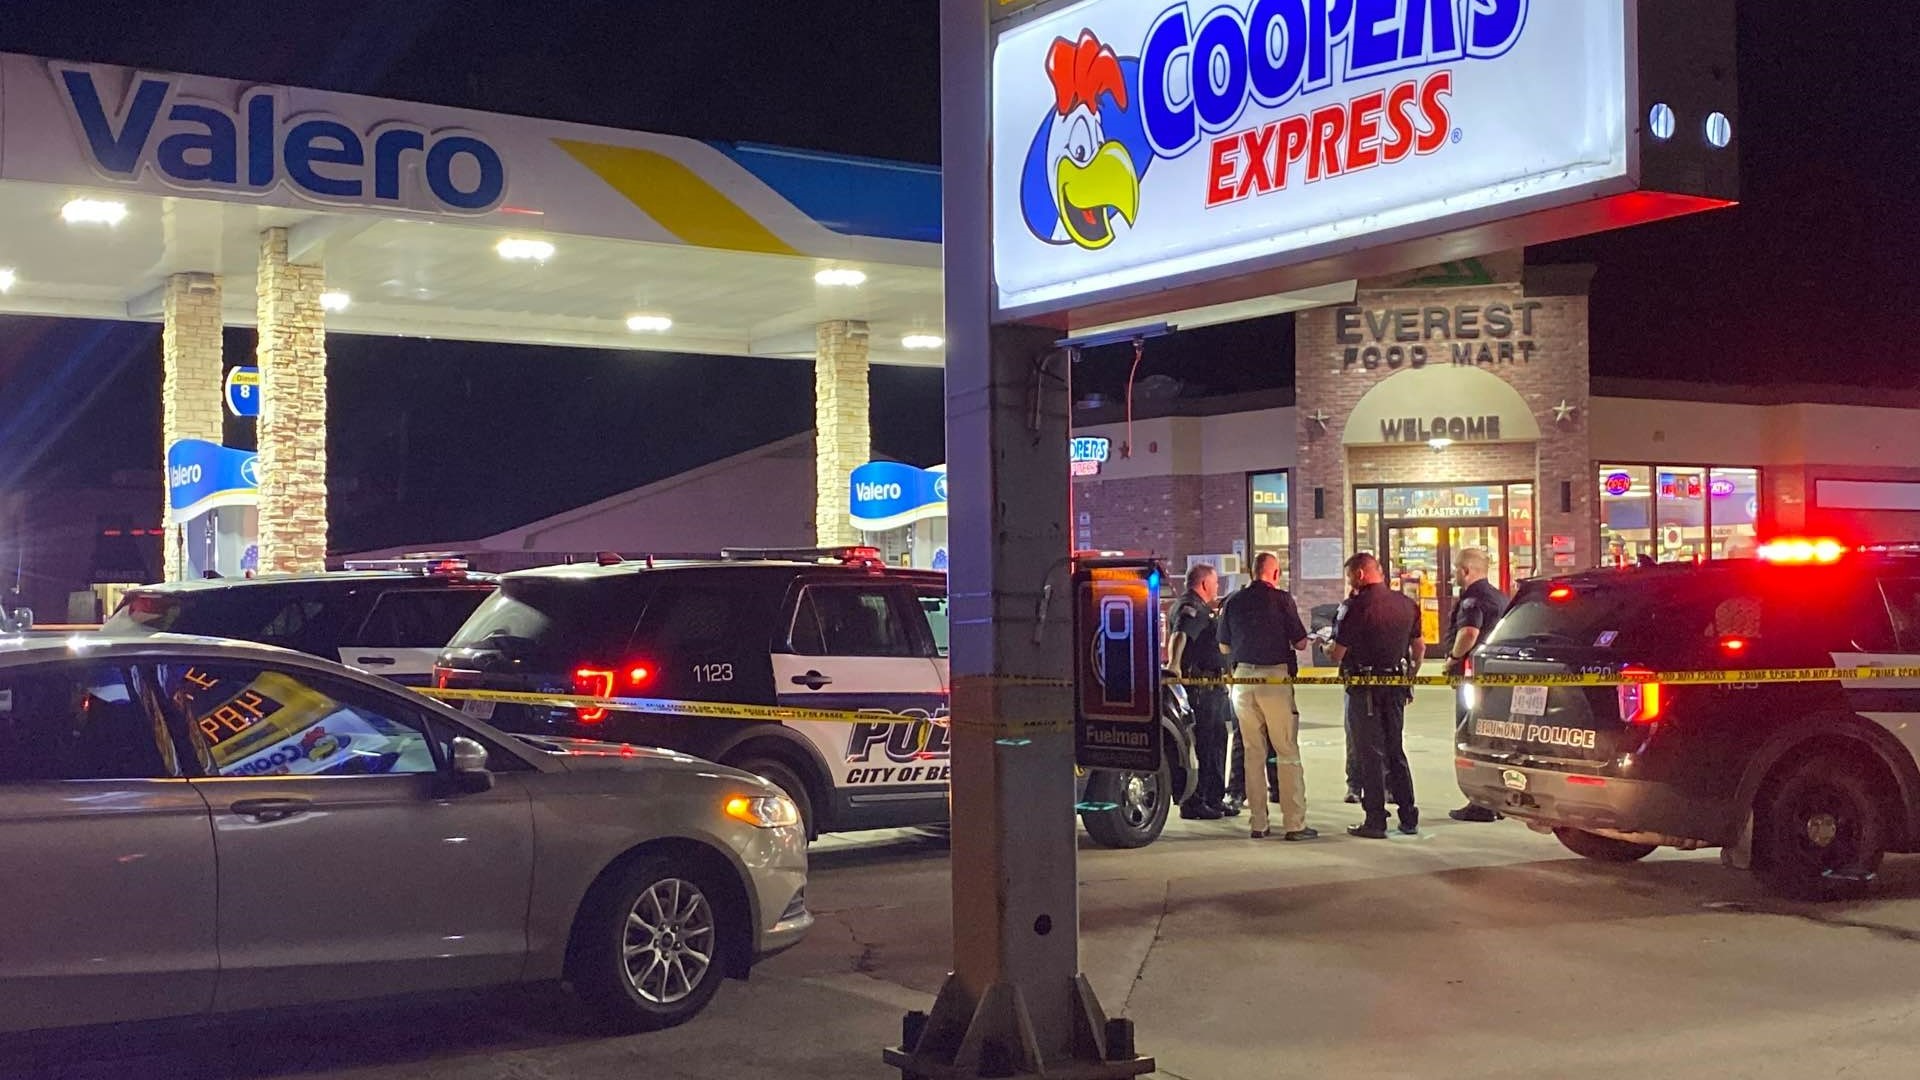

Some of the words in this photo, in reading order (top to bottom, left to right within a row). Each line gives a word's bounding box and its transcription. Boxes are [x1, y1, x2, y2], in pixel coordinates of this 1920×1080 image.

[62, 70, 504, 209] Valero
[1205, 70, 1452, 208] EXPRESS
[1336, 302, 1542, 344] EVEREST
[1343, 345, 1428, 370] FOOD
[1451, 340, 1536, 367] MART
[1380, 416, 1500, 442] WELCOME
[856, 481, 901, 502] Valero
[1607, 477, 1630, 490] OPEN
[1711, 481, 1731, 492] ATM
[1253, 490, 1285, 504] DELI
[693, 663, 733, 682] 1123
[1086, 725, 1149, 747] Fuelman
[1526, 724, 1596, 749] POLICE
[846, 767, 896, 784] CITY
[897, 766, 924, 782] OF
